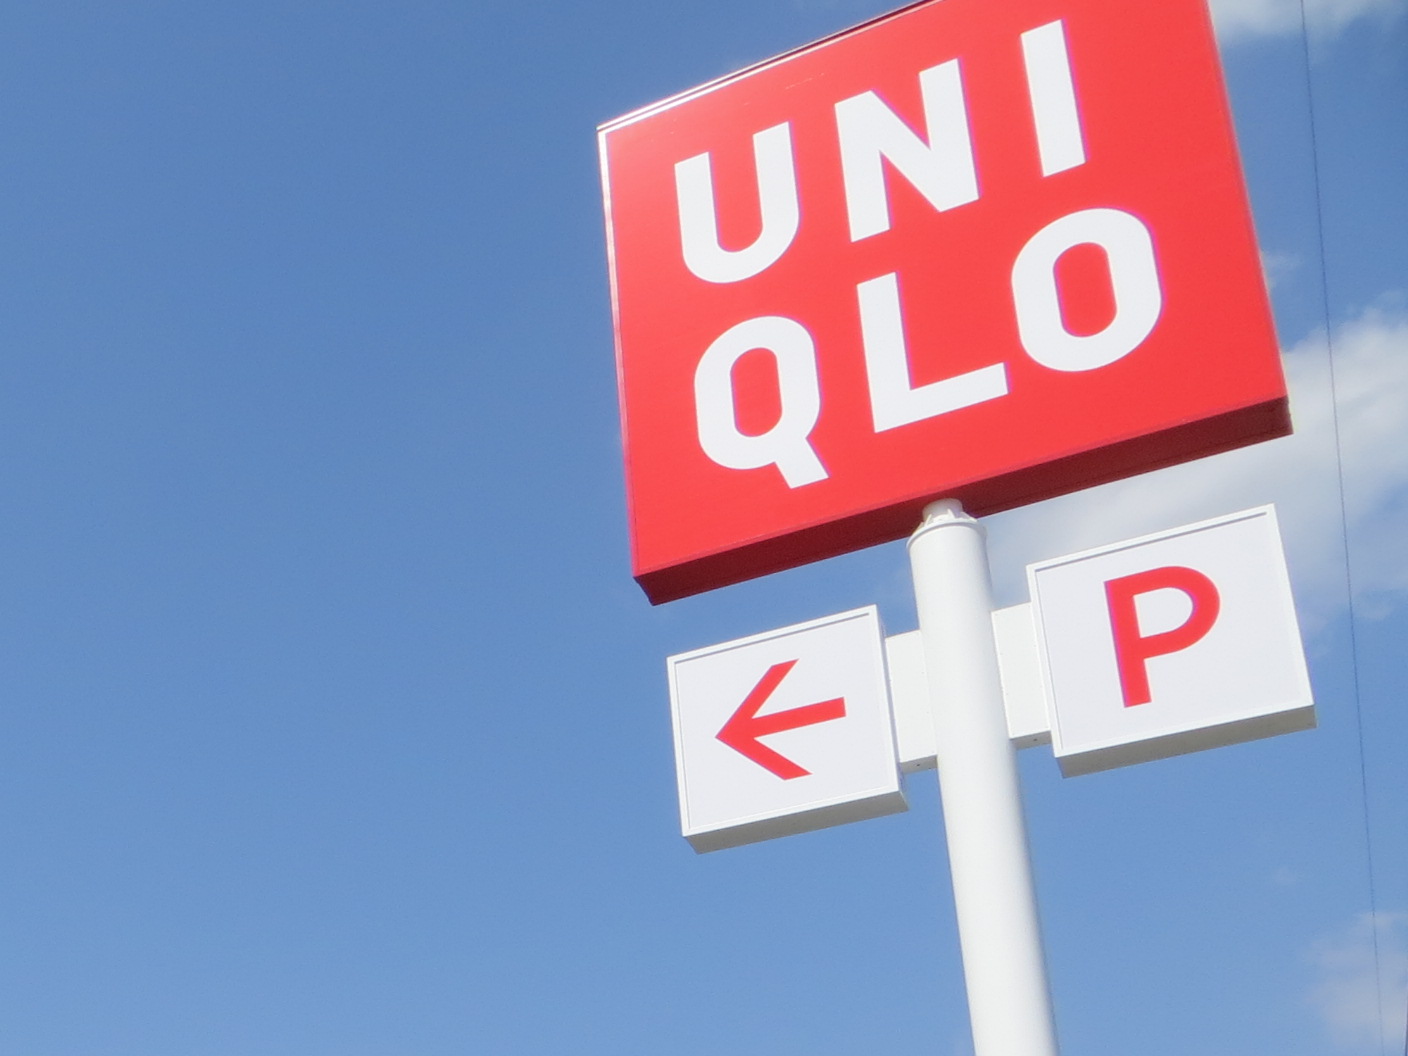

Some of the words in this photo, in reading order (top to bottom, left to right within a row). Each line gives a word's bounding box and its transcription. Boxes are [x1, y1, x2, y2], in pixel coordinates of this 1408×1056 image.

[674, 19, 1087, 284] UNI
[694, 207, 1163, 489] QLO
[1104, 565, 1221, 708] P
